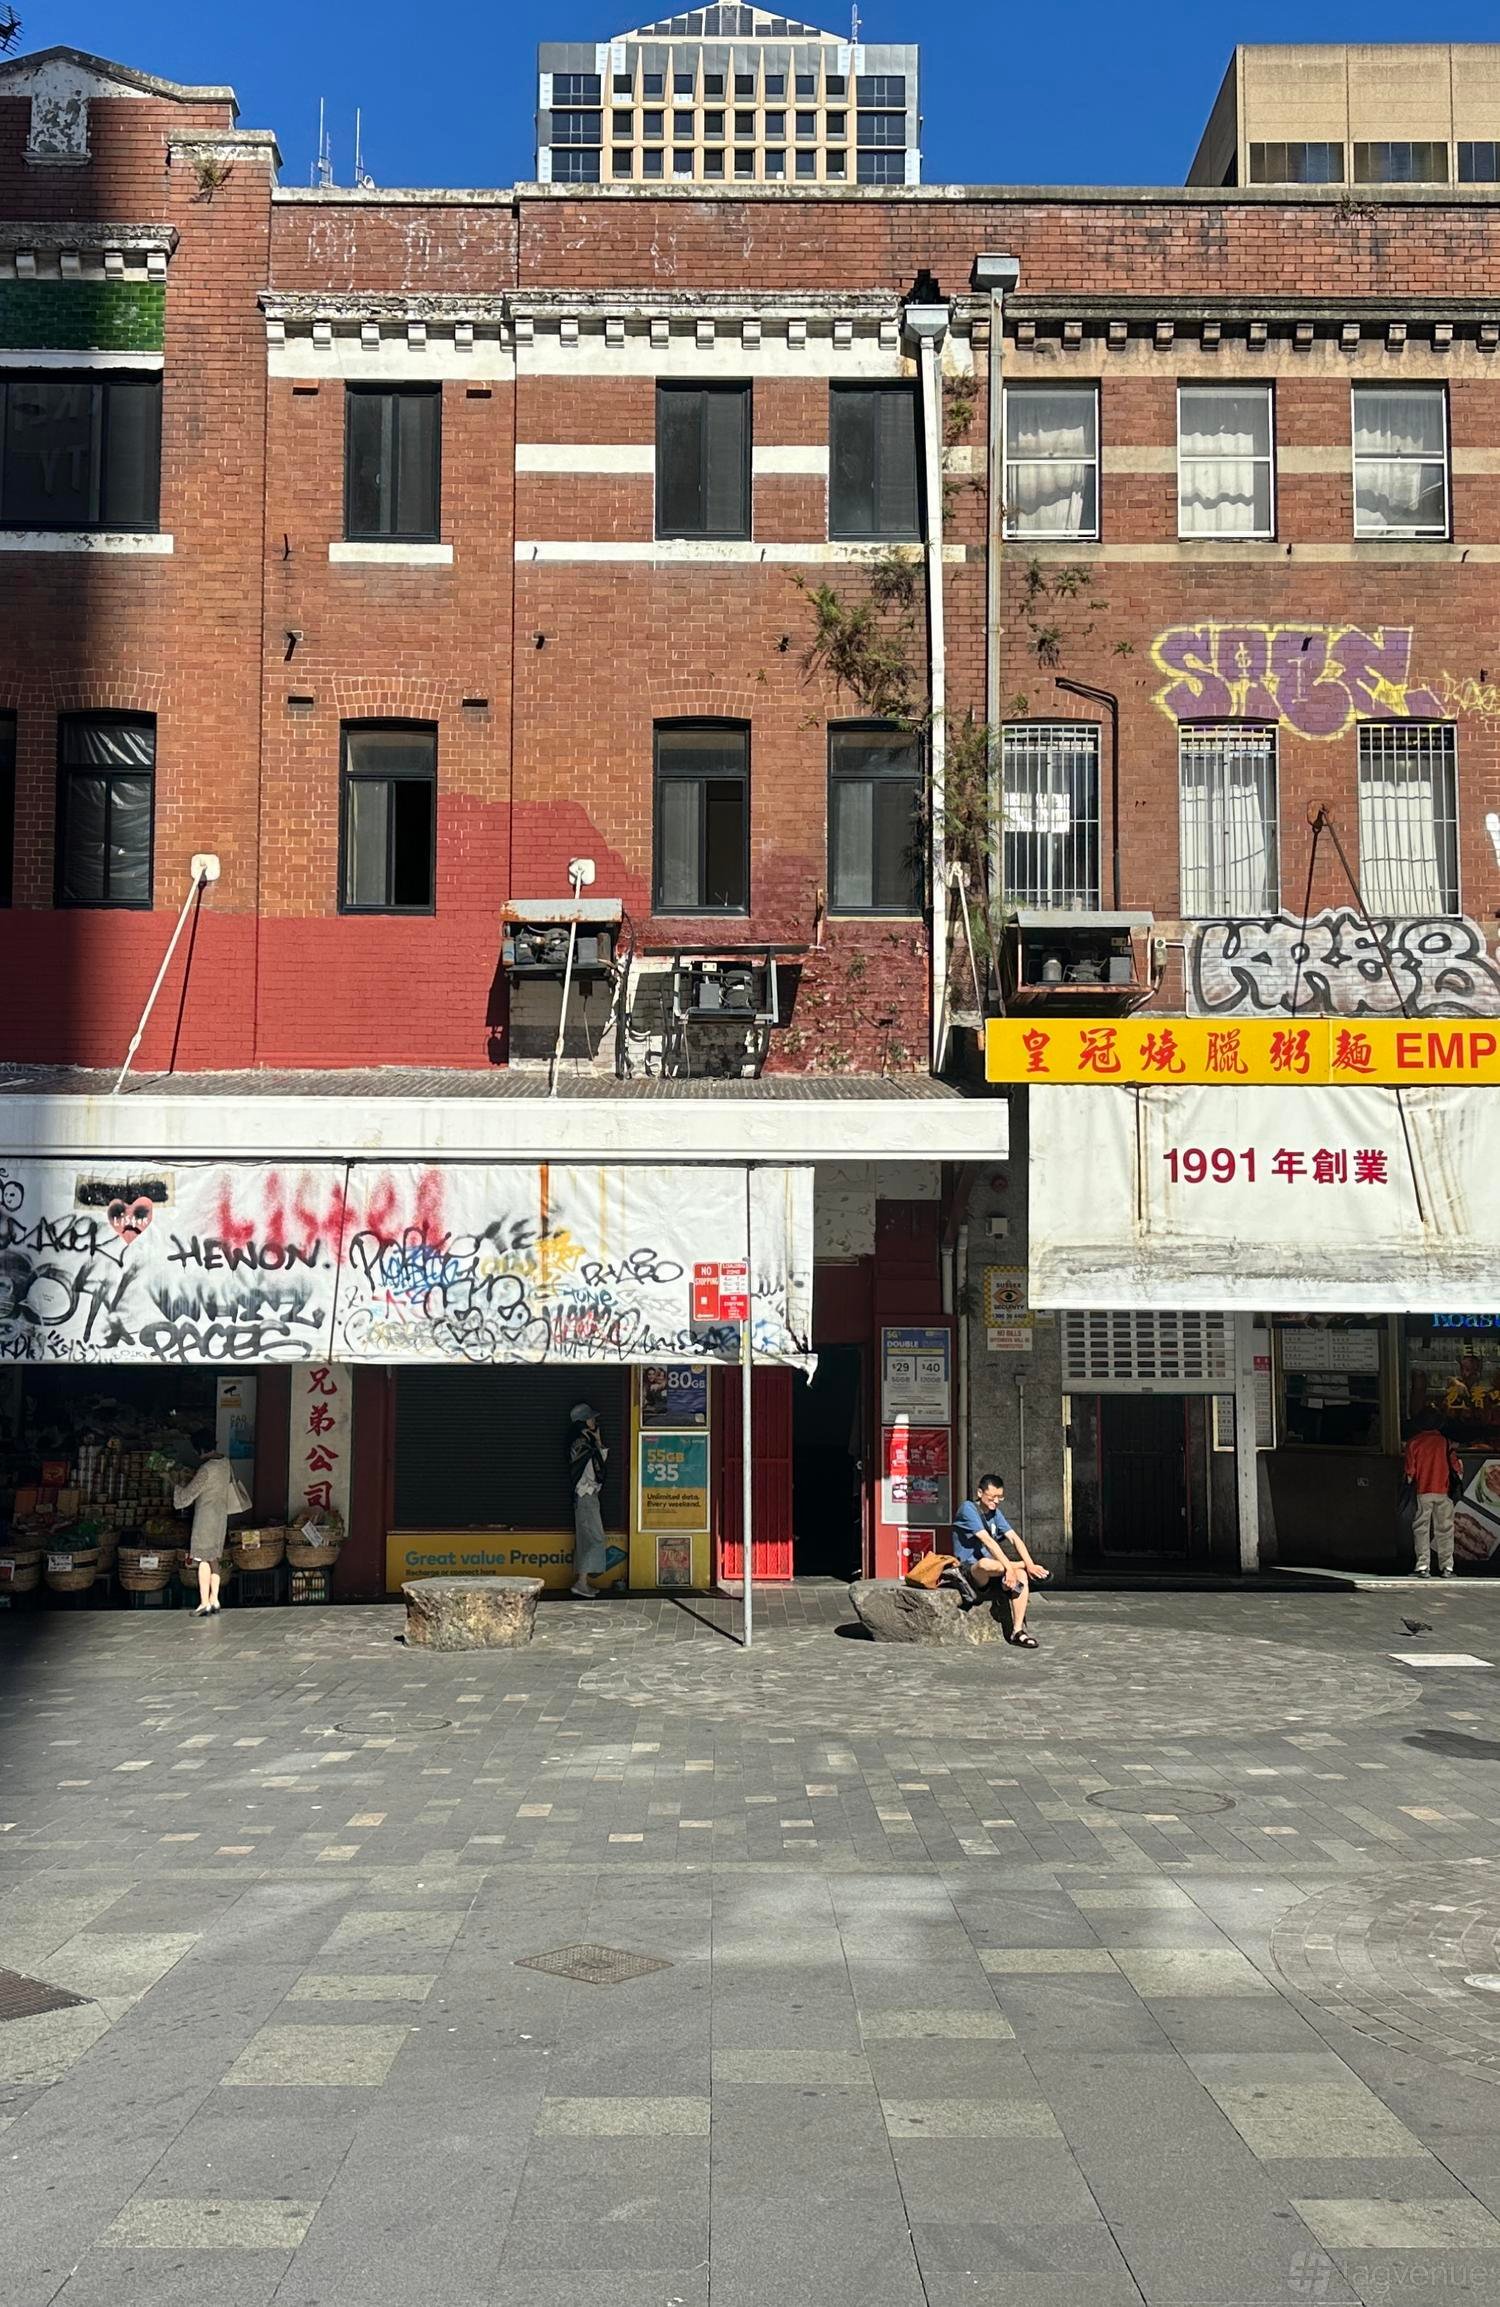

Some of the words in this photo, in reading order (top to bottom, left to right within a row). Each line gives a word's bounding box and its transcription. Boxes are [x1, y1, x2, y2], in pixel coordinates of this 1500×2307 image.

[1396, 1032, 1497, 1069] EMP
[1163, 1147, 1256, 1184] 1991
[701, 1266, 712, 1276] NO
[647, 1463, 679, 1481] $35
[405, 1552, 456, 1566] Great
[462, 1551, 504, 1565] value
